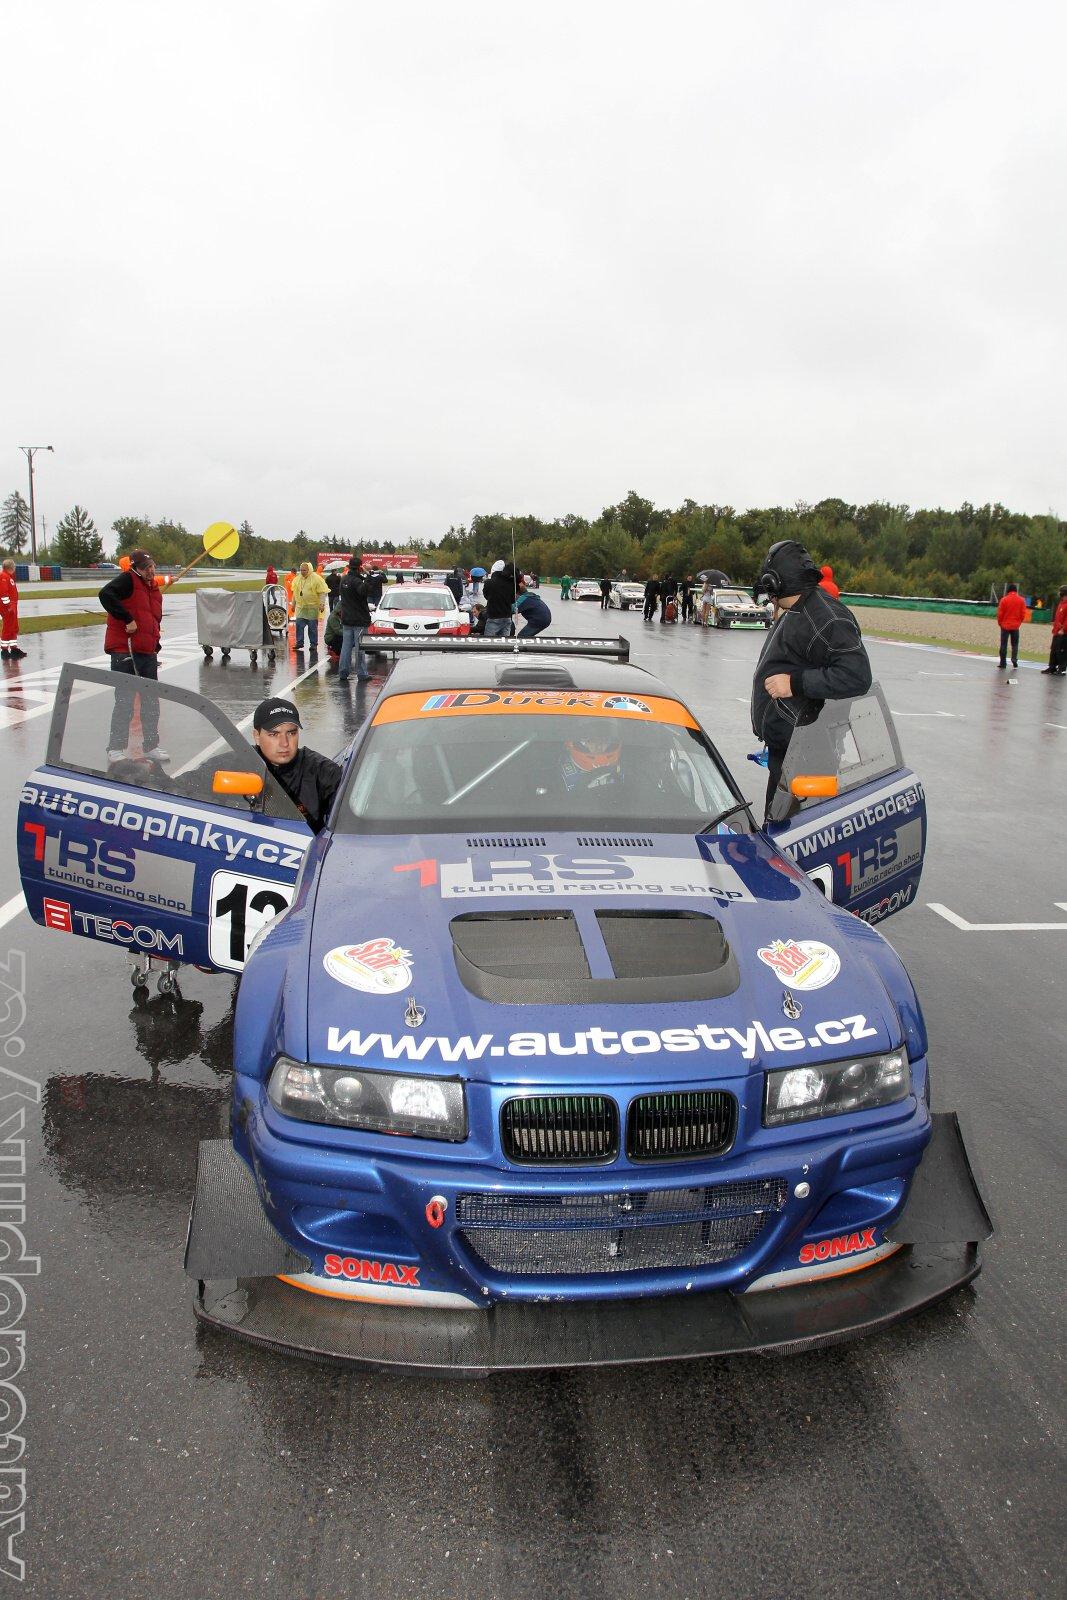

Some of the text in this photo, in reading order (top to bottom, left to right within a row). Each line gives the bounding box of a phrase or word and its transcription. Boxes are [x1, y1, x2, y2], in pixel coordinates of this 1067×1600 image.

[370, 635, 615, 647] www.autodoplnky.cz
[20, 786, 305, 870] autodoplnky.cz
[48, 866, 186, 911] tuning racing shop
[451, 881, 743, 902] tuning racing shop
[853, 852, 920, 893] tuning racing shop
[74, 910, 184, 956] TECOM
[761, 942, 810, 976] Star
[326, 1014, 878, 1062] www.autostyle.cz
[799, 1227, 877, 1264] SONAX
[324, 1253, 420, 1287] SONAX
